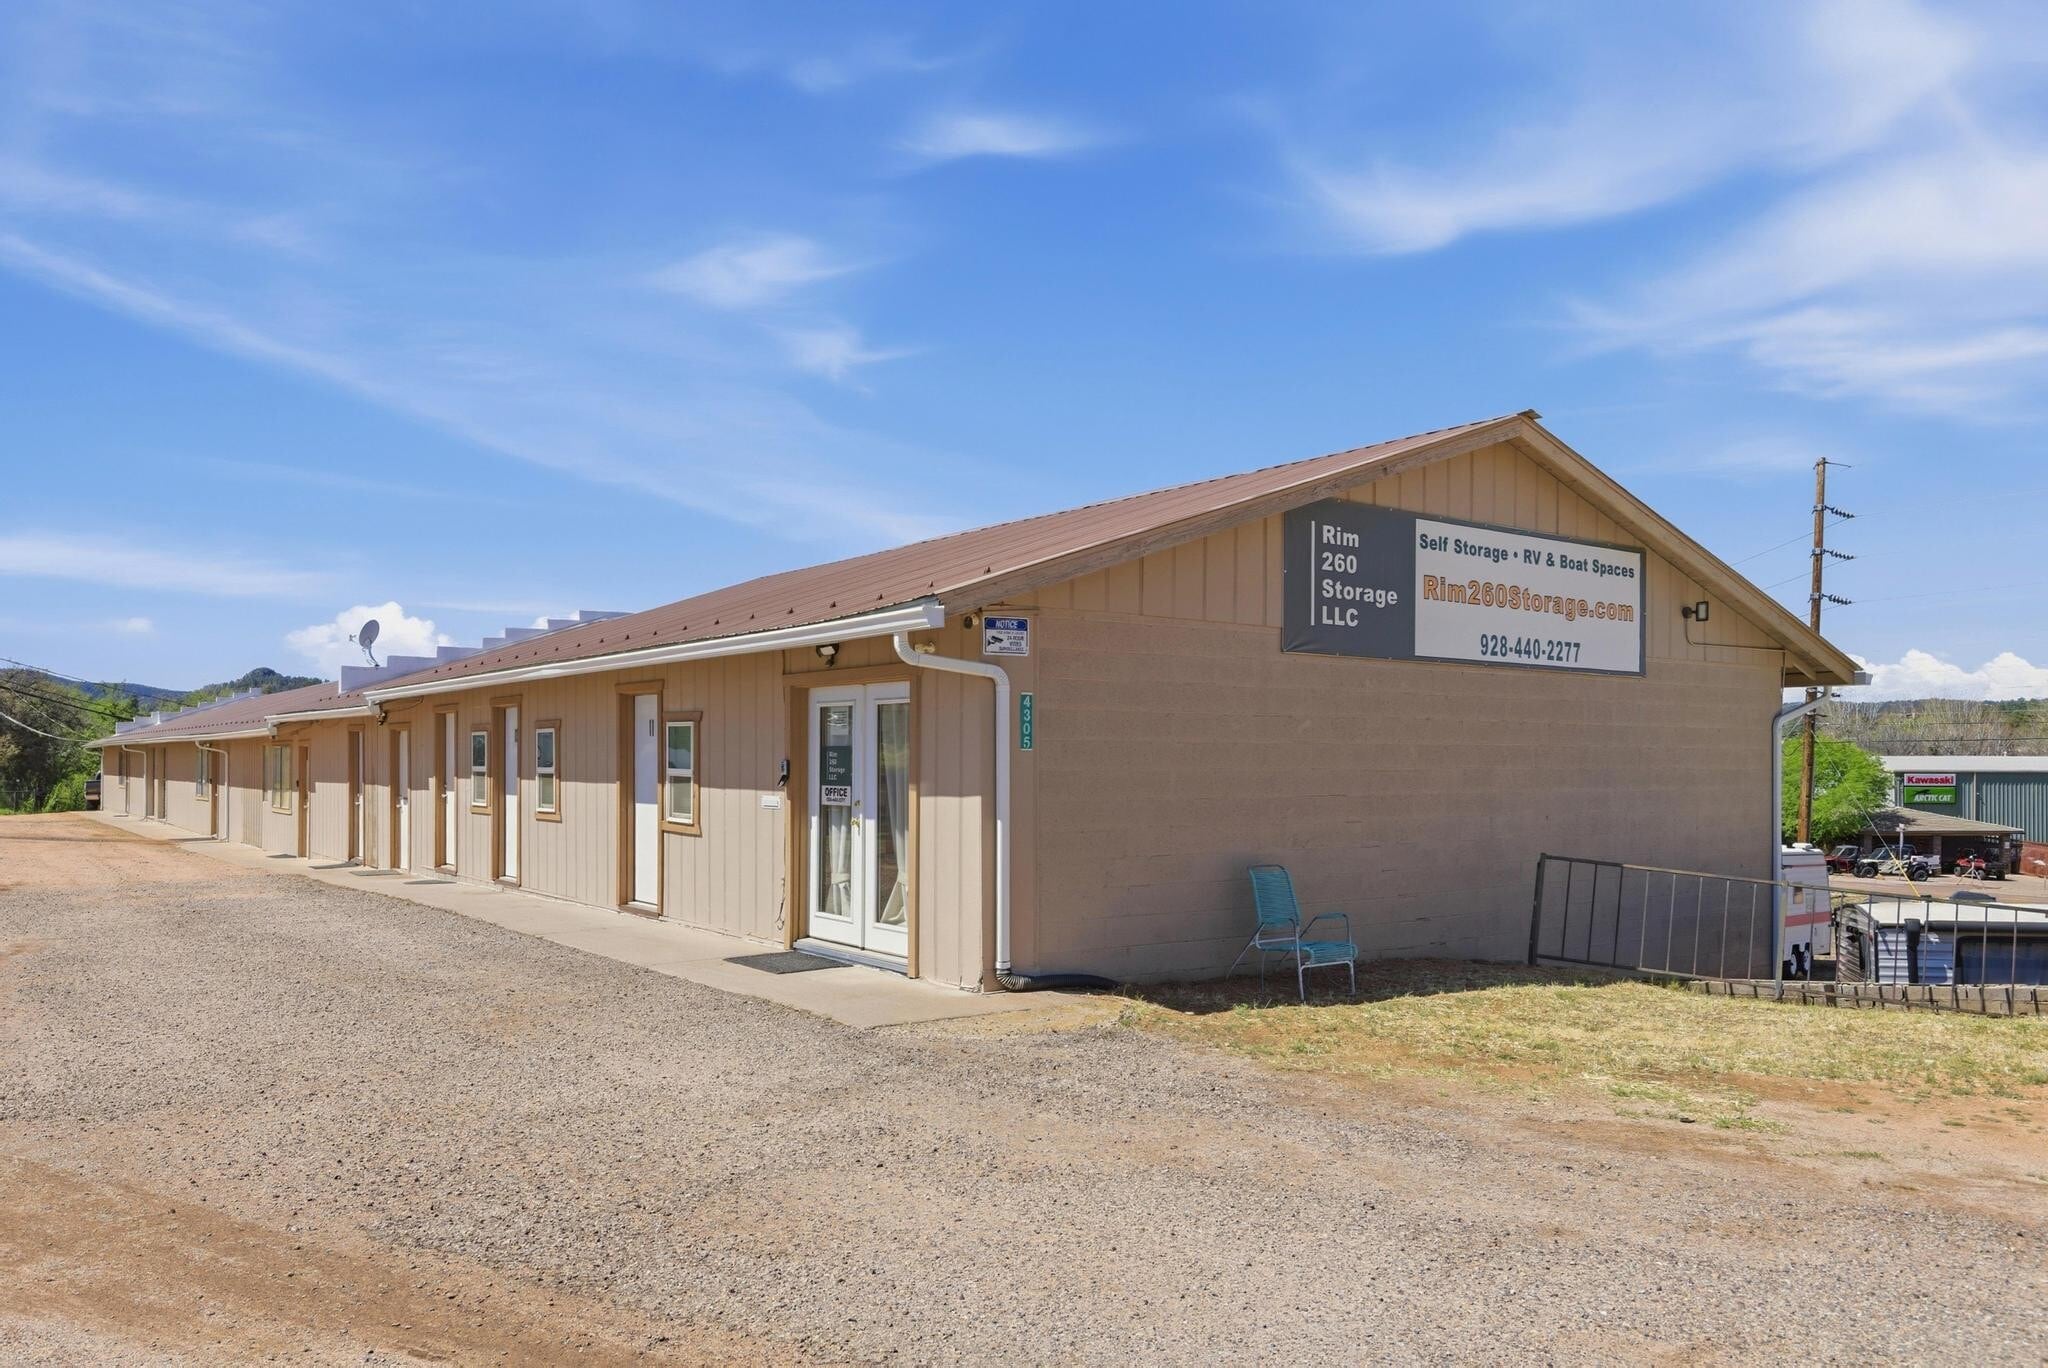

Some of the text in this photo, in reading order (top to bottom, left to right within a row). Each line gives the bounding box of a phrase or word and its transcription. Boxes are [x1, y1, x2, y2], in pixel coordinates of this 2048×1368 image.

[1322, 525, 1360, 548] Rim
[1322, 551, 1358, 574] 260
[1420, 533, 1635, 579] Self Storage RV & Boat Spaces
[1322, 579, 1398, 610] Storage
[1423, 574, 1634, 622] Rim260Storage.com
[995, 620, 1018, 629] NOTICE
[1322, 605, 1359, 627] LLC
[1480, 633, 1581, 663] 928-440-2277
[1023, 695, 1031, 748] 4305
[1907, 776, 1954, 784] Kawasaki
[825, 787, 848, 797] OFFICE
[1914, 794, 1953, 802] ARCTIC CAT
